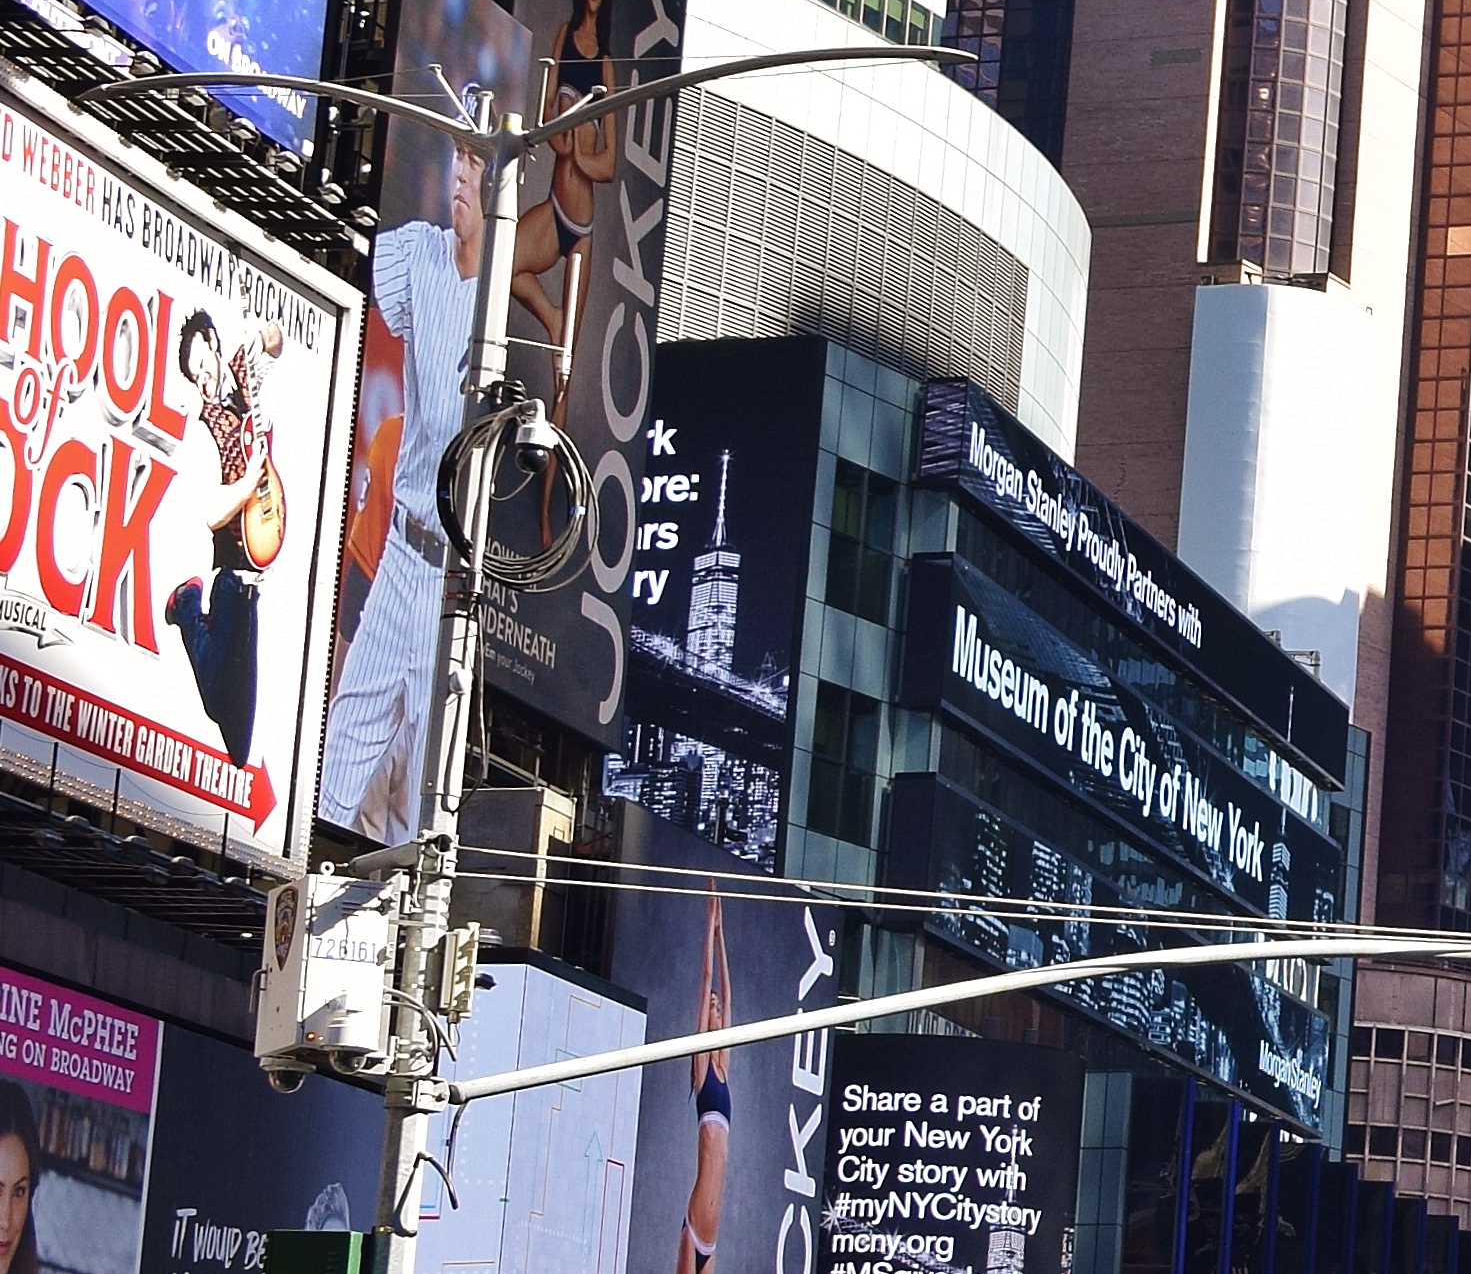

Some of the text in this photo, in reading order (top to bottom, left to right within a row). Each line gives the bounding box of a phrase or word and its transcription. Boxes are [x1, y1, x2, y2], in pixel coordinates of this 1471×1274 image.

[22, 124, 96, 215] WEBBER
[101, 175, 136, 240] HAS
[142, 202, 240, 301] BROADWAY
[969, 421, 1203, 649] Morgan Stanley Proudly Partners with
[21, 675, 255, 809] TO THE WINTER GARDEN THEATRE
[953, 605, 1266, 882] Museum of the City of New York
[22, 1038, 135, 1094] ON BROADWAY
[842, 1084, 1043, 1123] Share a part of
[838, 1121, 1034, 1158] your New York
[837, 1155, 1028, 1194] City story with
[172, 1207, 199, 1260] IT
[194, 1225, 242, 1270] WOULD
[834, 1191, 1042, 1235] #myNYCitystory
[831, 1230, 955, 1264] mcny.org
